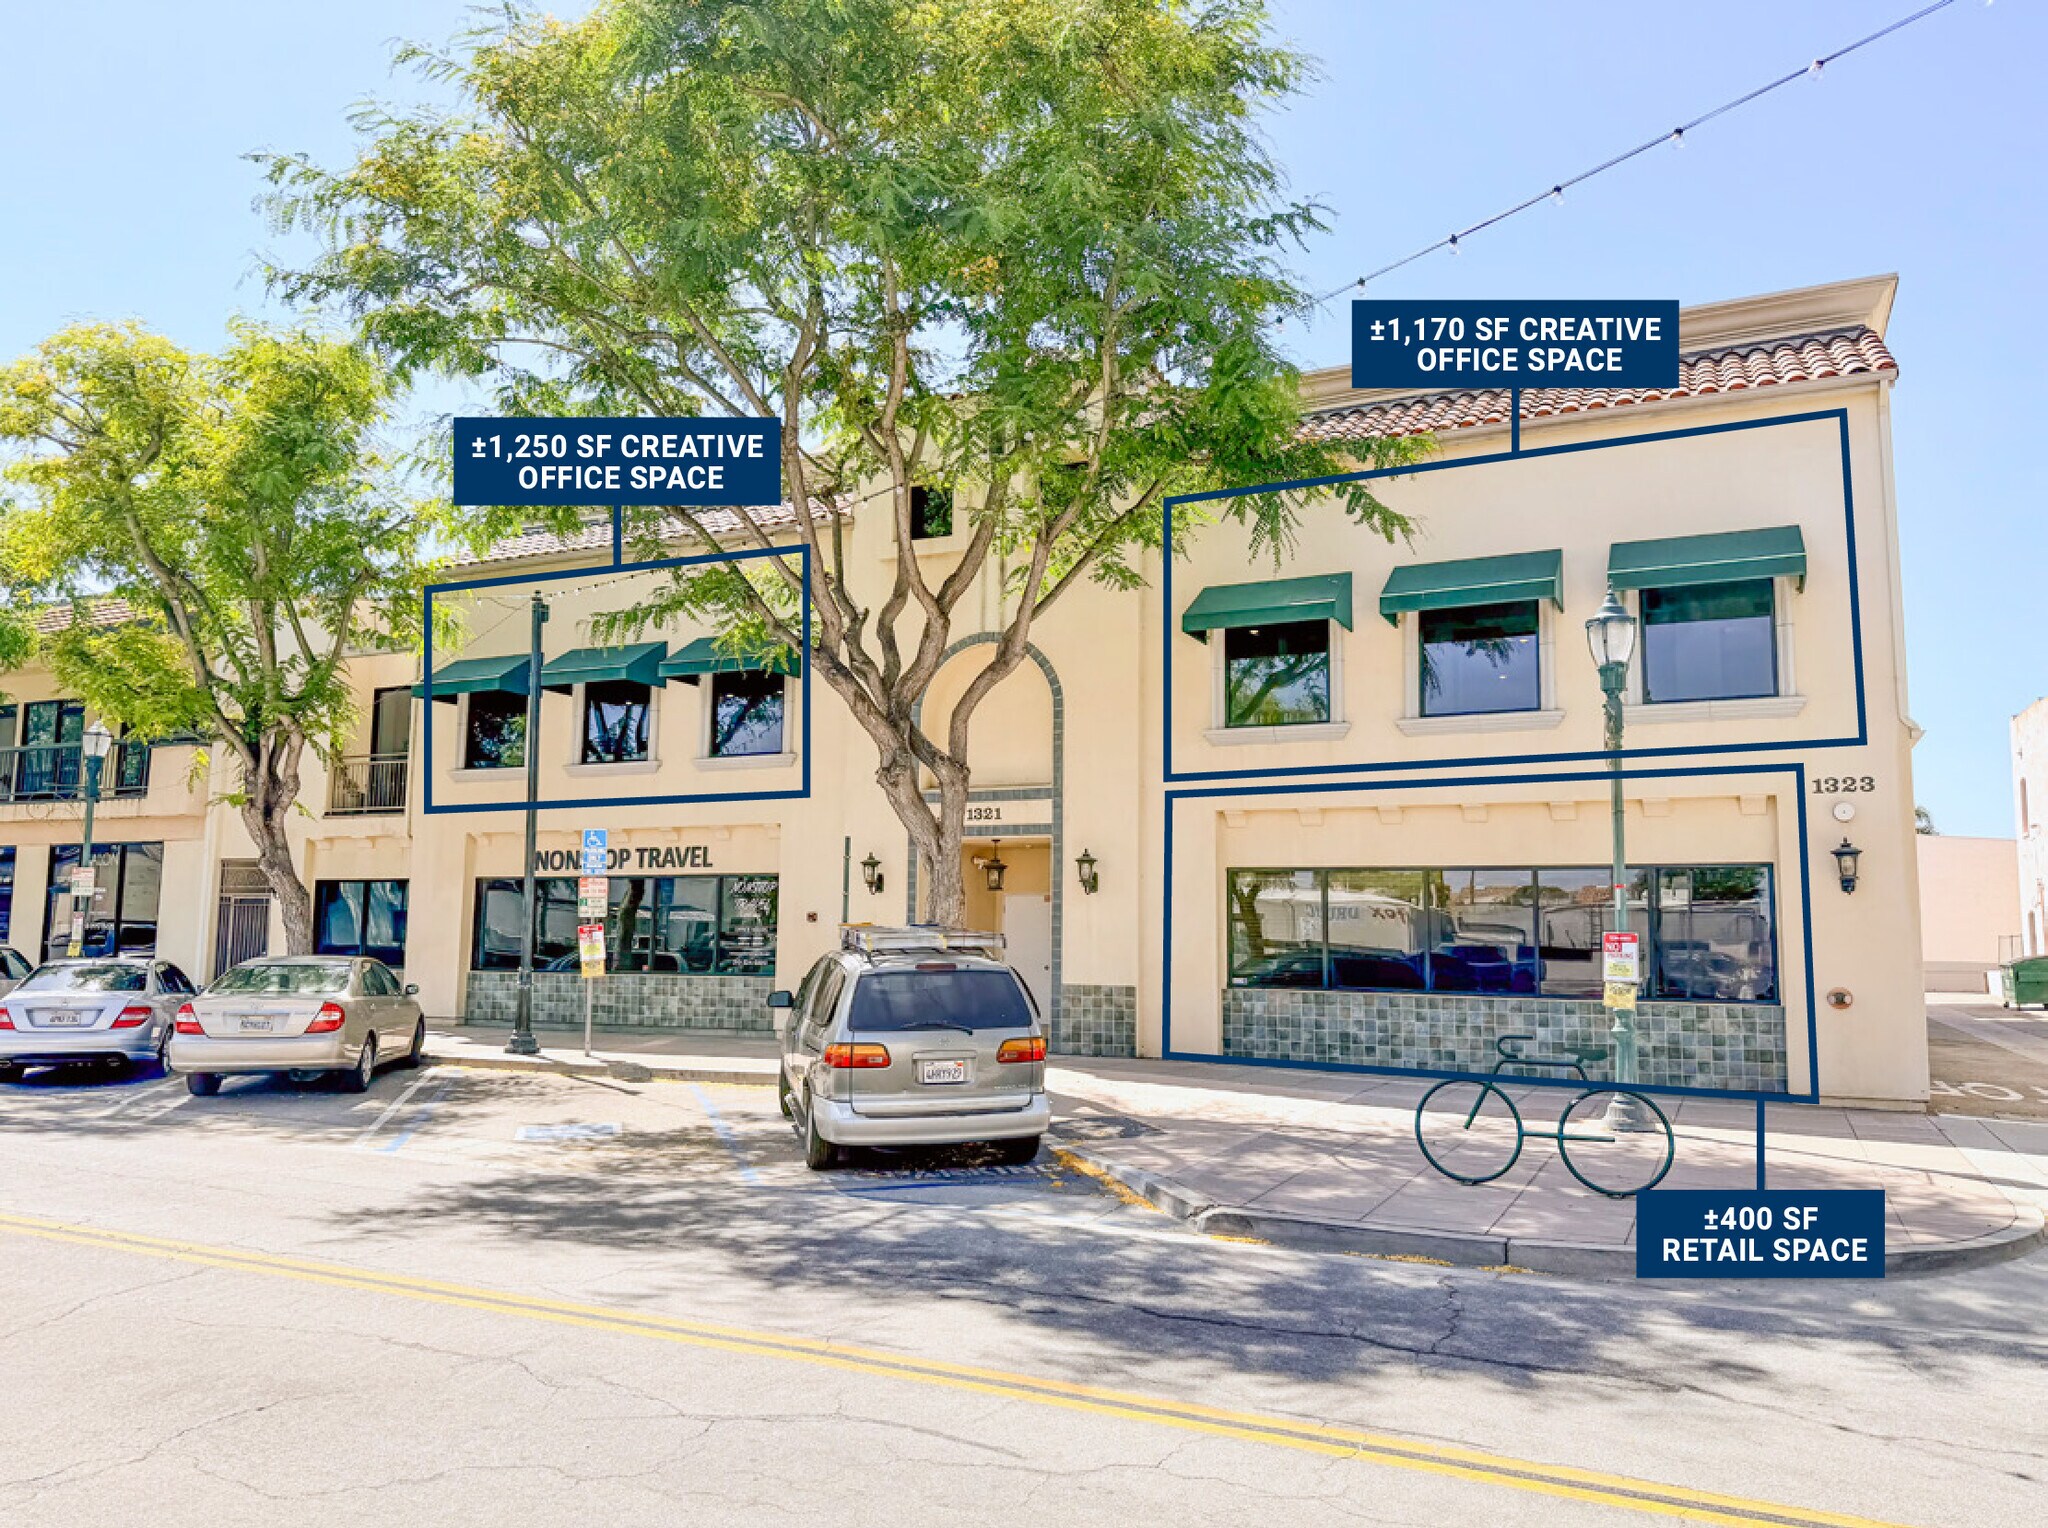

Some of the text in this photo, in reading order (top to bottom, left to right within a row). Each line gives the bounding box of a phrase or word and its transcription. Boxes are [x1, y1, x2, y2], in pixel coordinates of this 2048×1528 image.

[1811, 776, 1875, 794] 1323
[967, 807, 1002, 820] 1321
[535, 848, 631, 872] NONOP
[635, 846, 713, 868] TRAVEL
